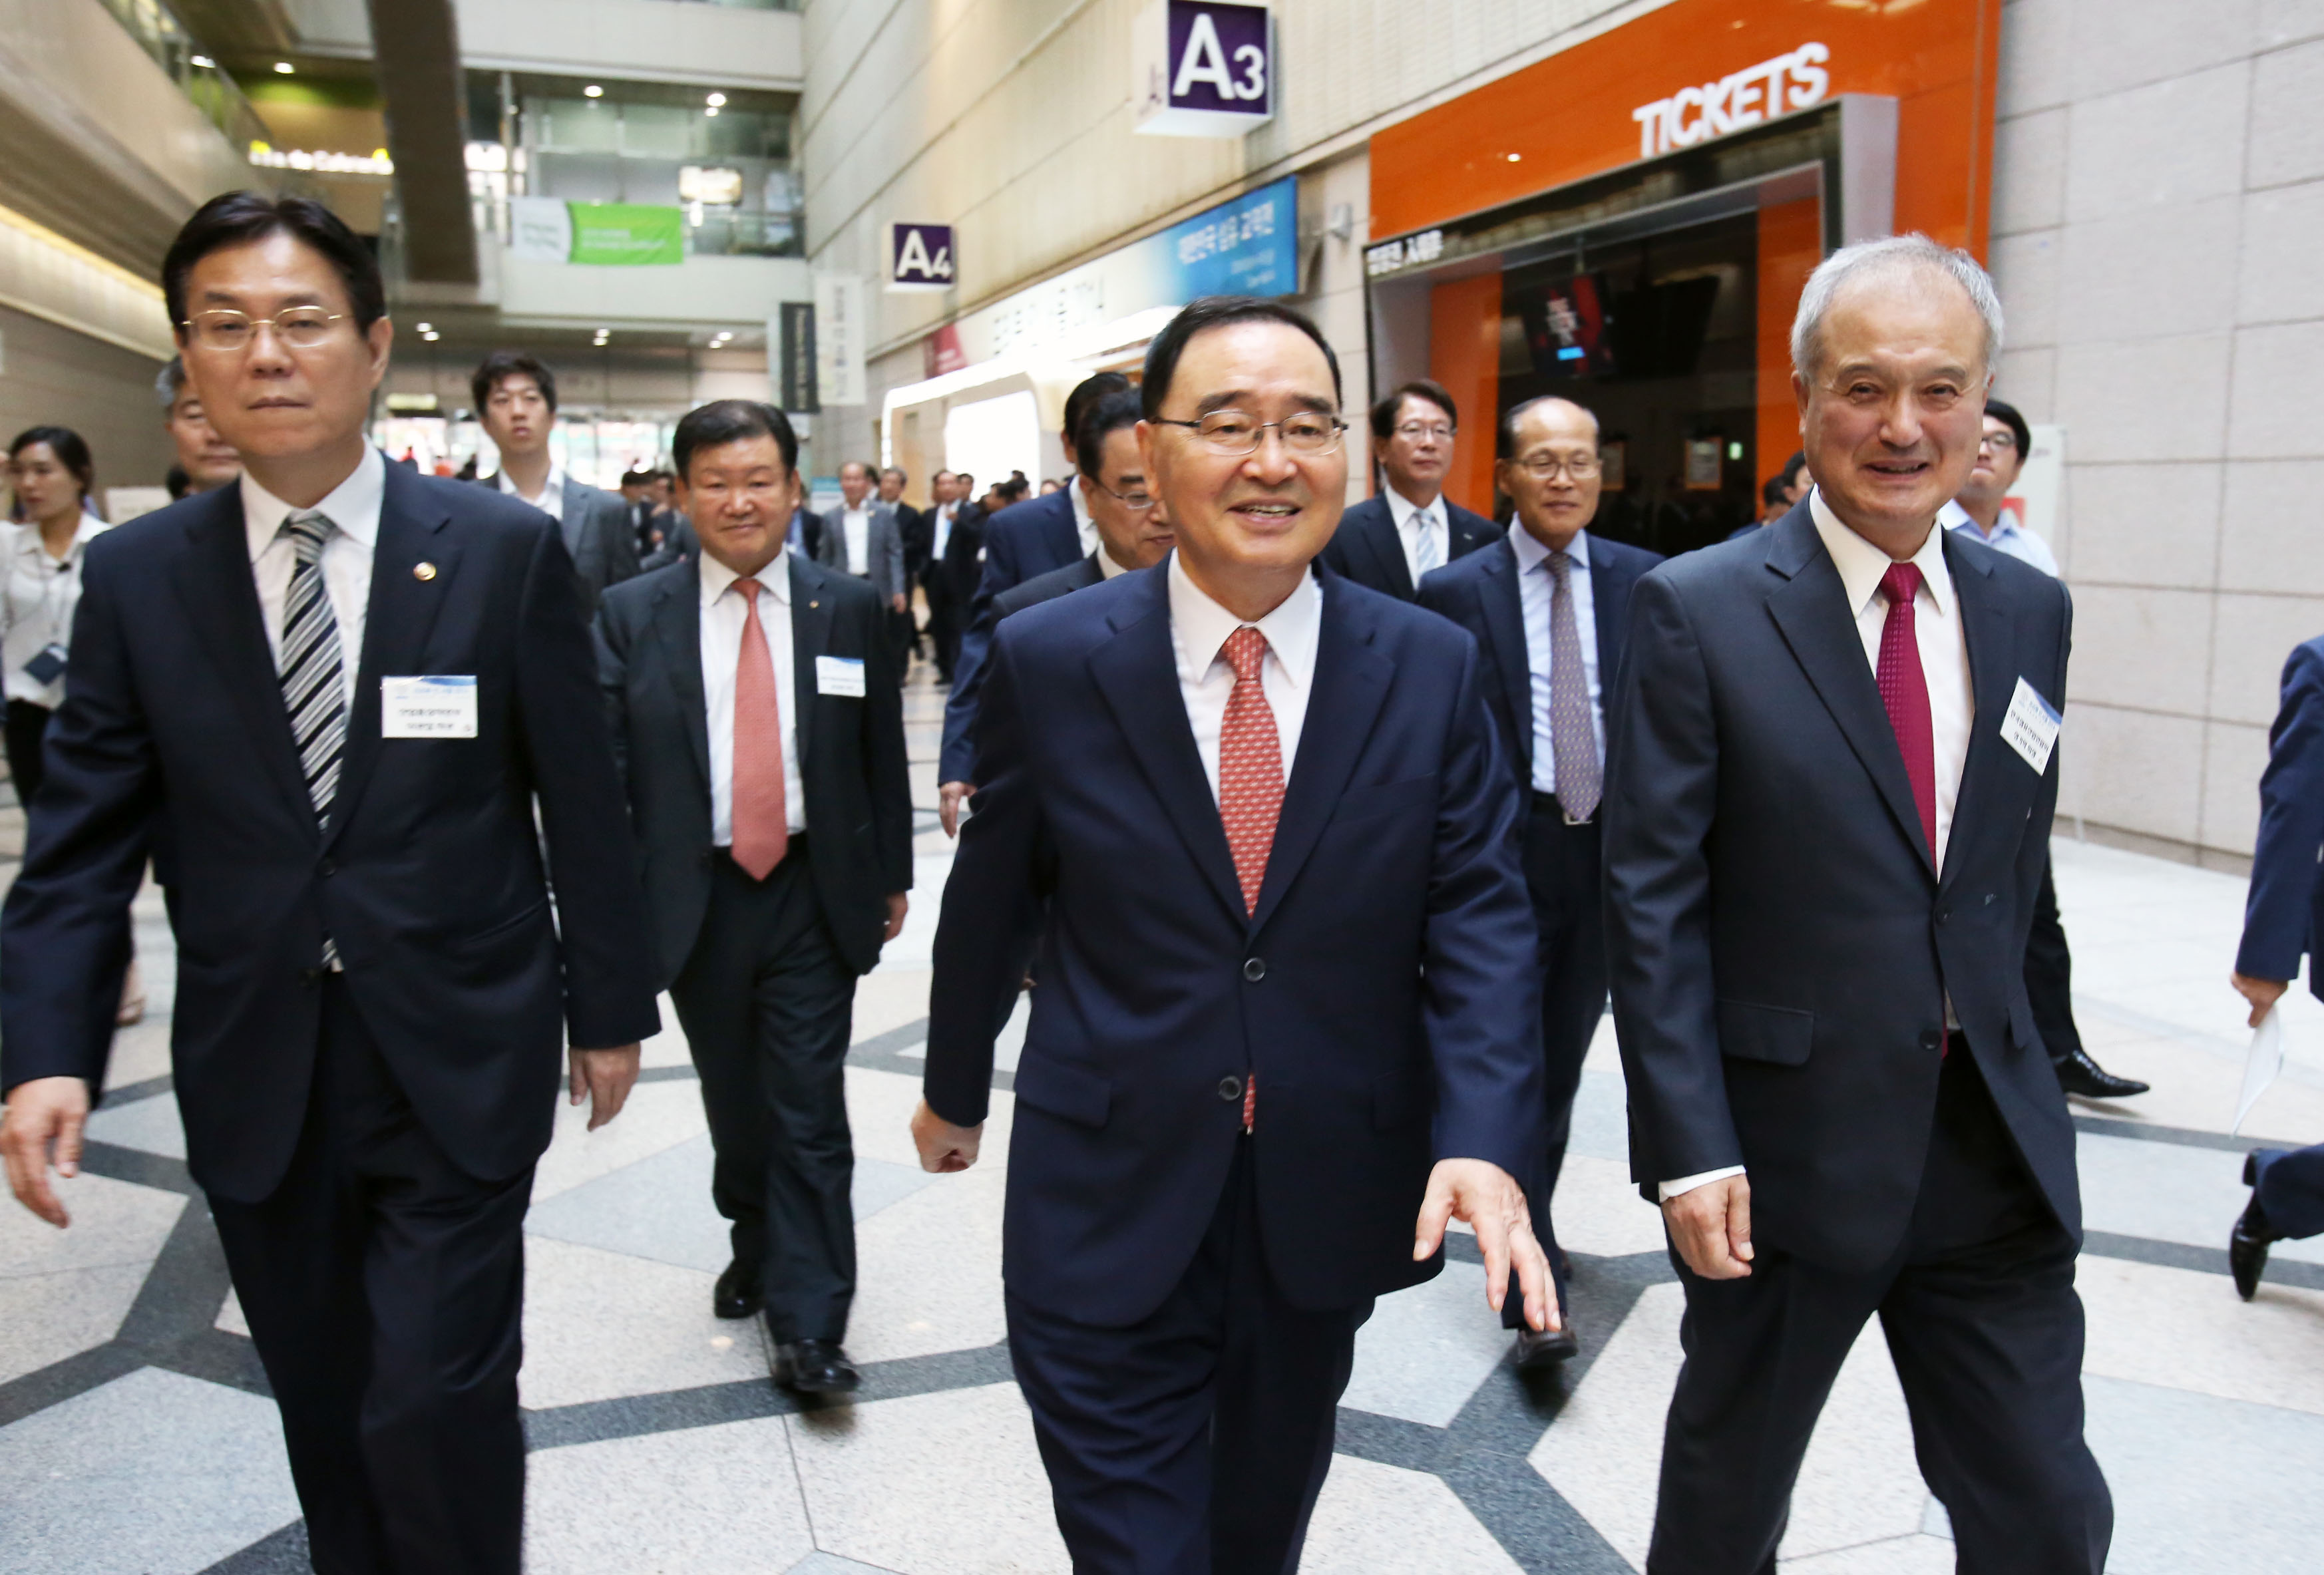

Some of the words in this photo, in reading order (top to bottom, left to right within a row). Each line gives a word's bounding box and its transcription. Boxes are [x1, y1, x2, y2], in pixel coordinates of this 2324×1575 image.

[1172, 13, 1264, 100] A3
[1633, 41, 1830, 158] TICKETS
[896, 229, 952, 278] A4
